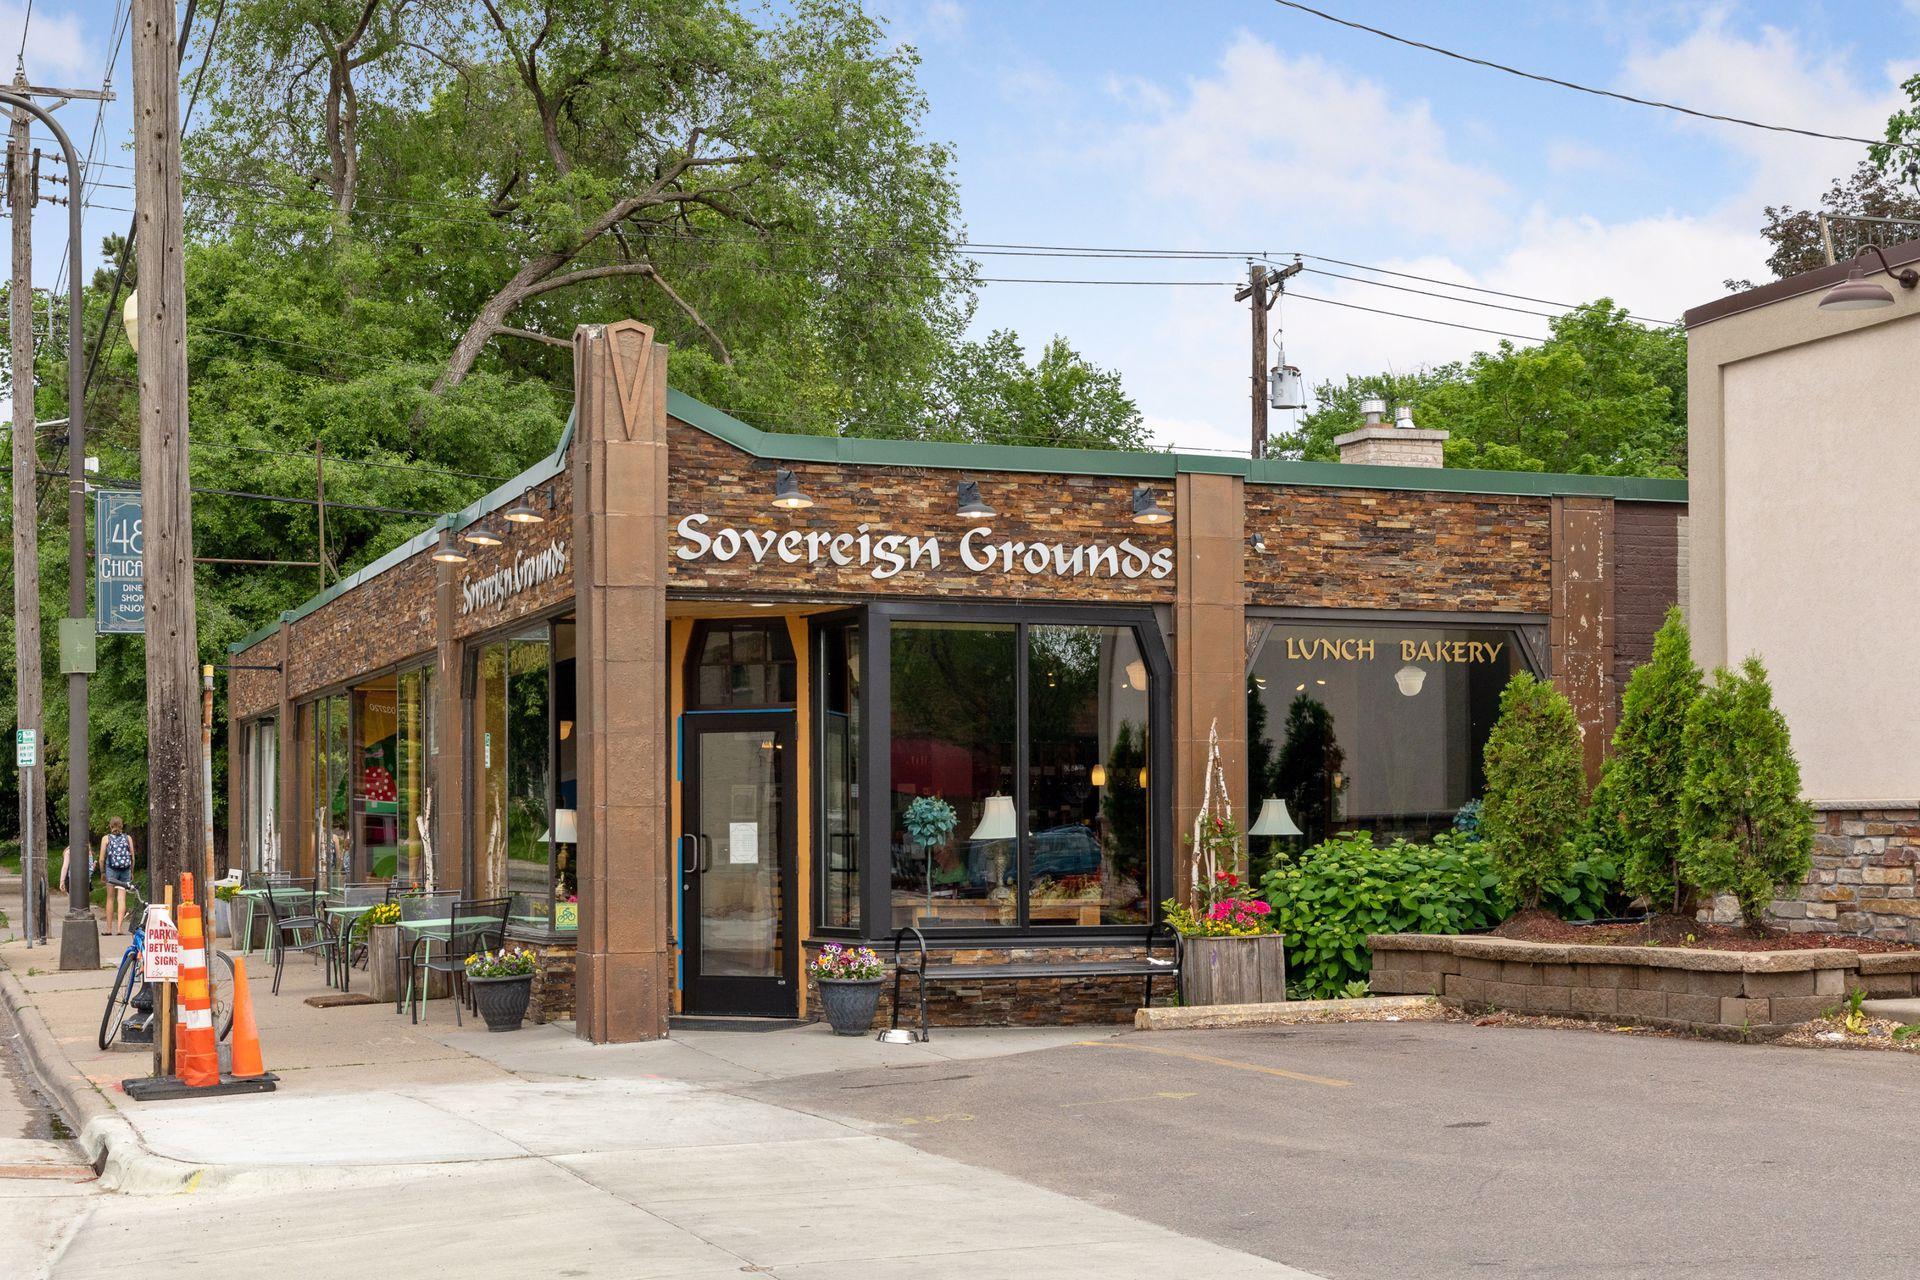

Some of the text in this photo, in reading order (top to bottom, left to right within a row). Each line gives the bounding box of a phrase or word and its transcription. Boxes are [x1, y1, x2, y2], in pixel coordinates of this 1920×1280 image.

[677, 514, 1173, 579] Sovereign Grounds
[102, 558, 143, 578] CHICA
[123, 584, 143, 592] DINE
[121, 594, 144, 603] SHOP
[1286, 637, 1503, 664] LUNCH BAKERY
[149, 929, 178, 939] PARKIN
[149, 943, 178, 953] BETWEE
[154, 956, 178, 966] SIGNS
